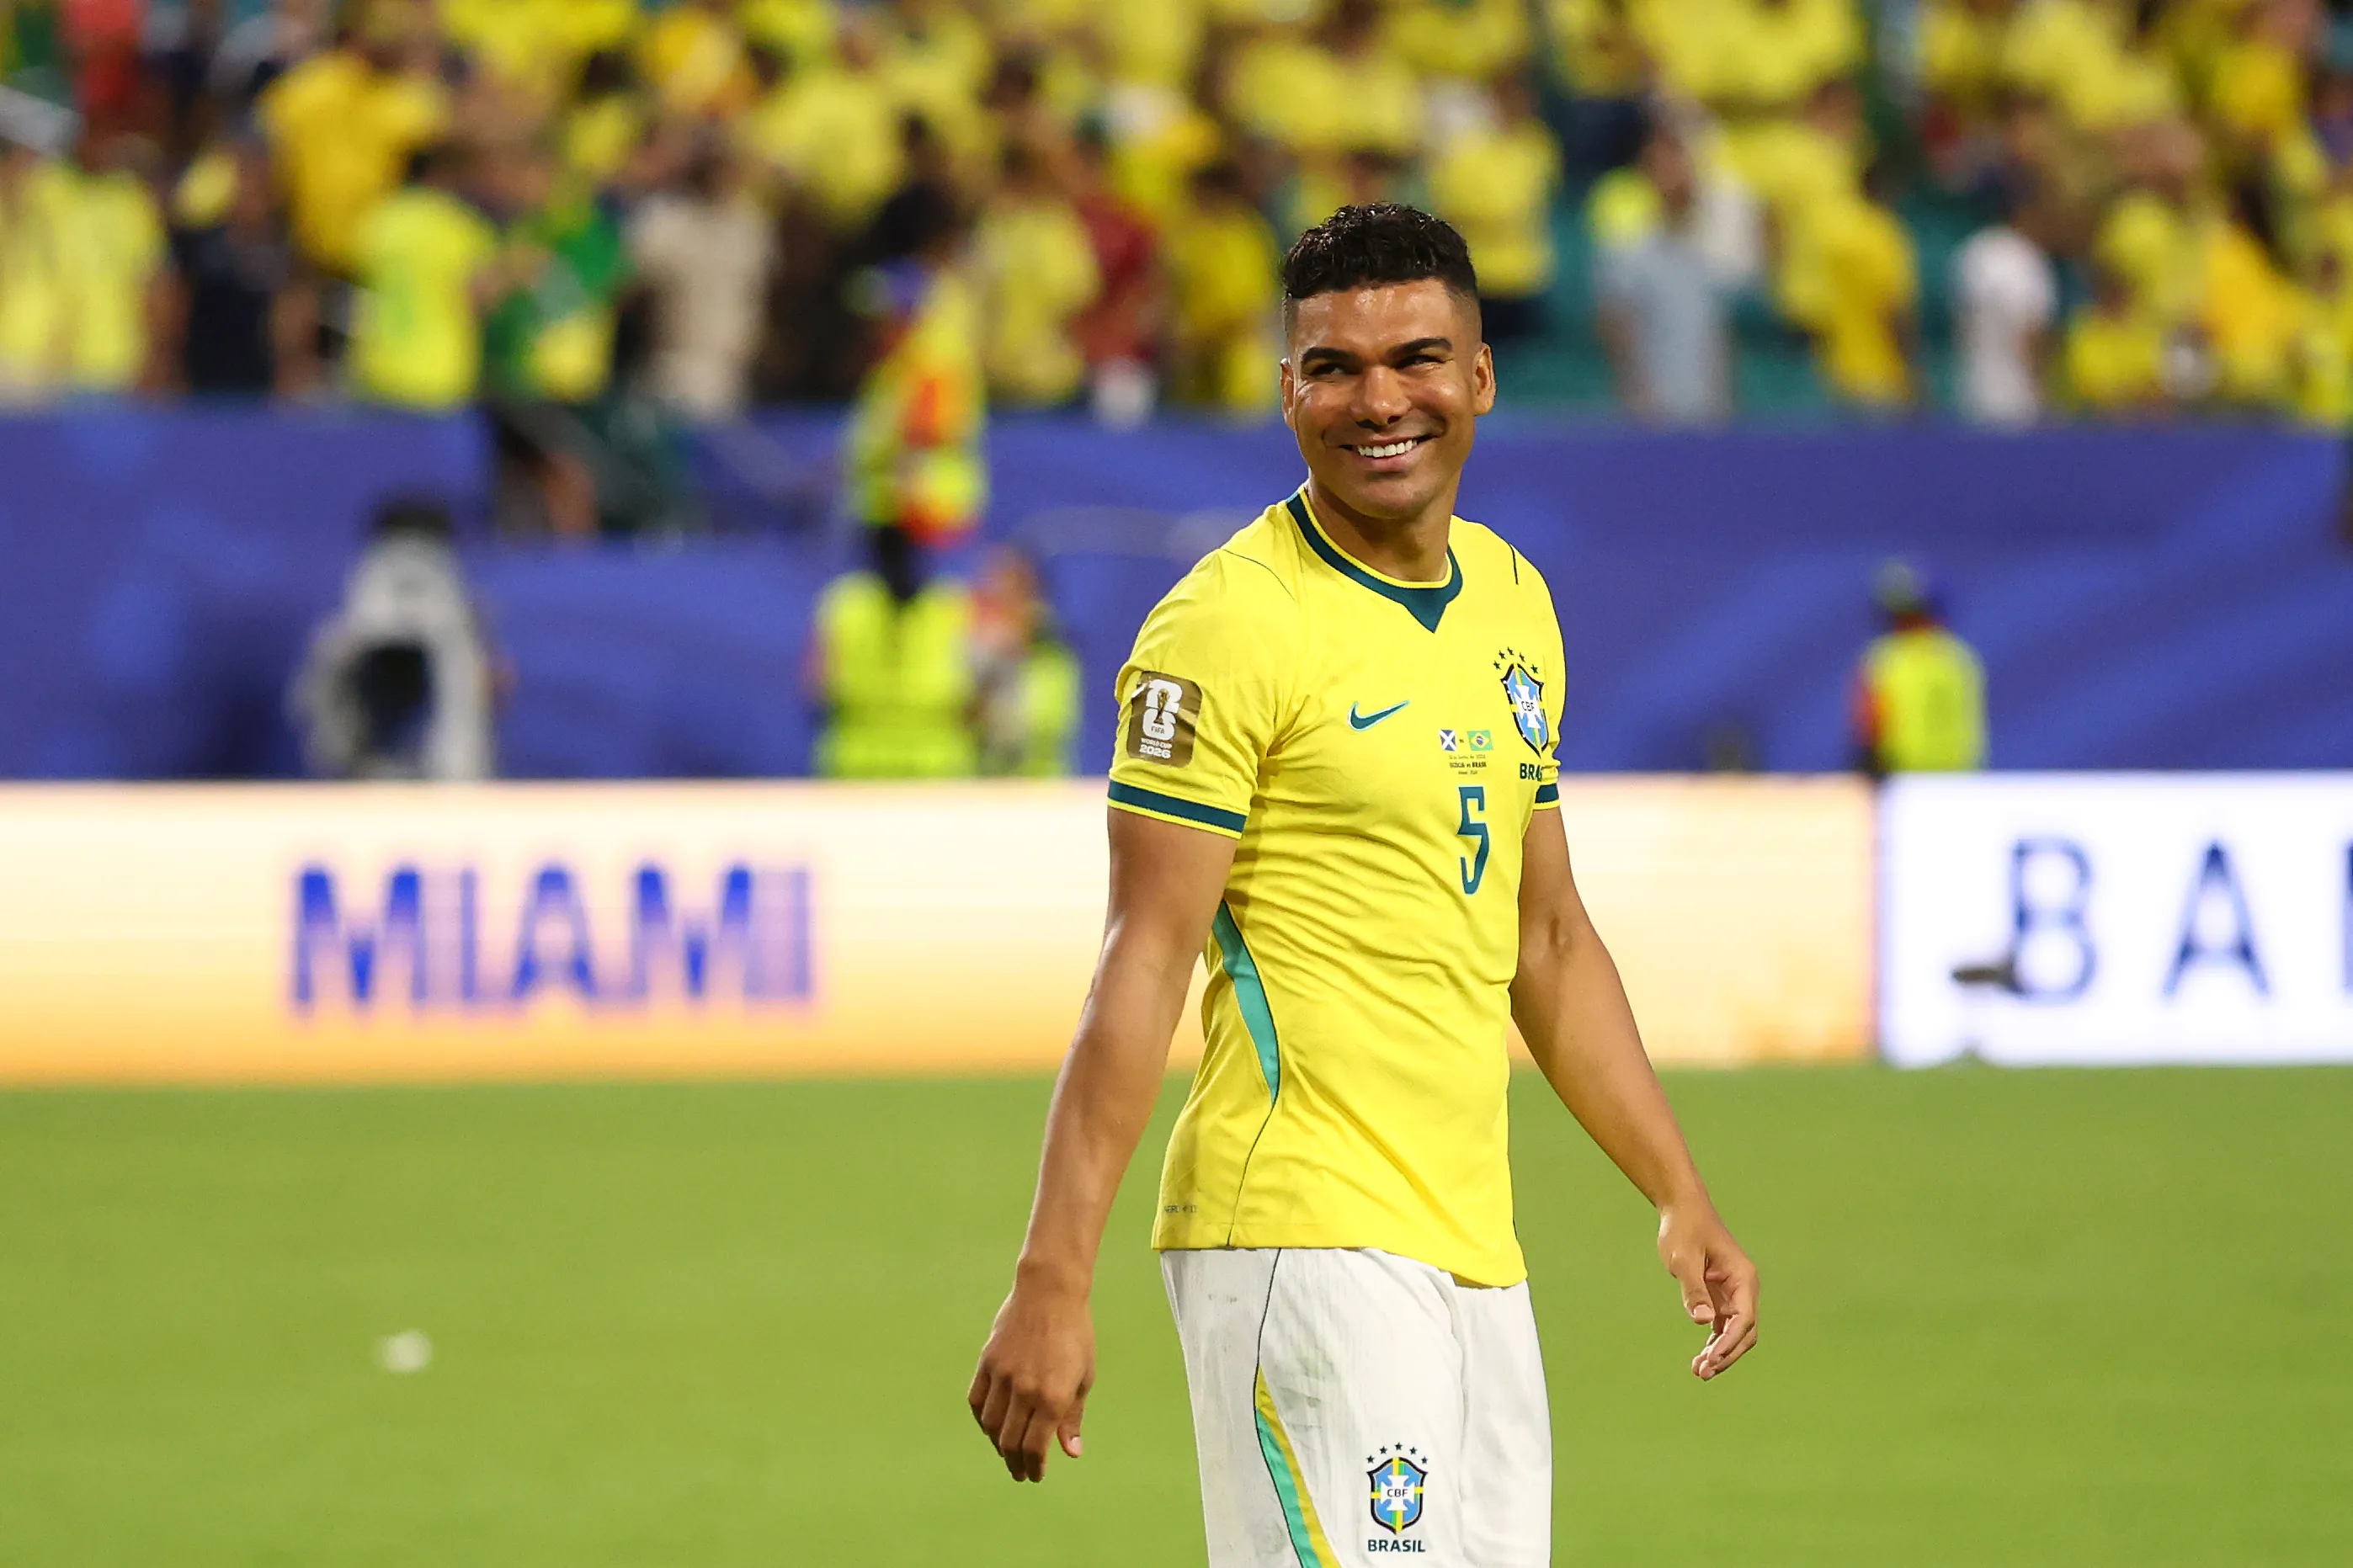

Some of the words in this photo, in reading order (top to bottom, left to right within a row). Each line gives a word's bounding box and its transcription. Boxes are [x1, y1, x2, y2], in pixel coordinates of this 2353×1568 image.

[1521, 700, 1535, 712] CBF
[1151, 726, 1165, 734] FIFA
[1141, 737, 1159, 747] WORLD
[1139, 744, 1171, 759] 2026
[1520, 763, 1542, 782] BRA
[1457, 785, 1489, 895] 5
[293, 867, 811, 1004] MIAMI
[1387, 1488, 1408, 1497] CBF
[1367, 1539, 1426, 1553] BRASIL
